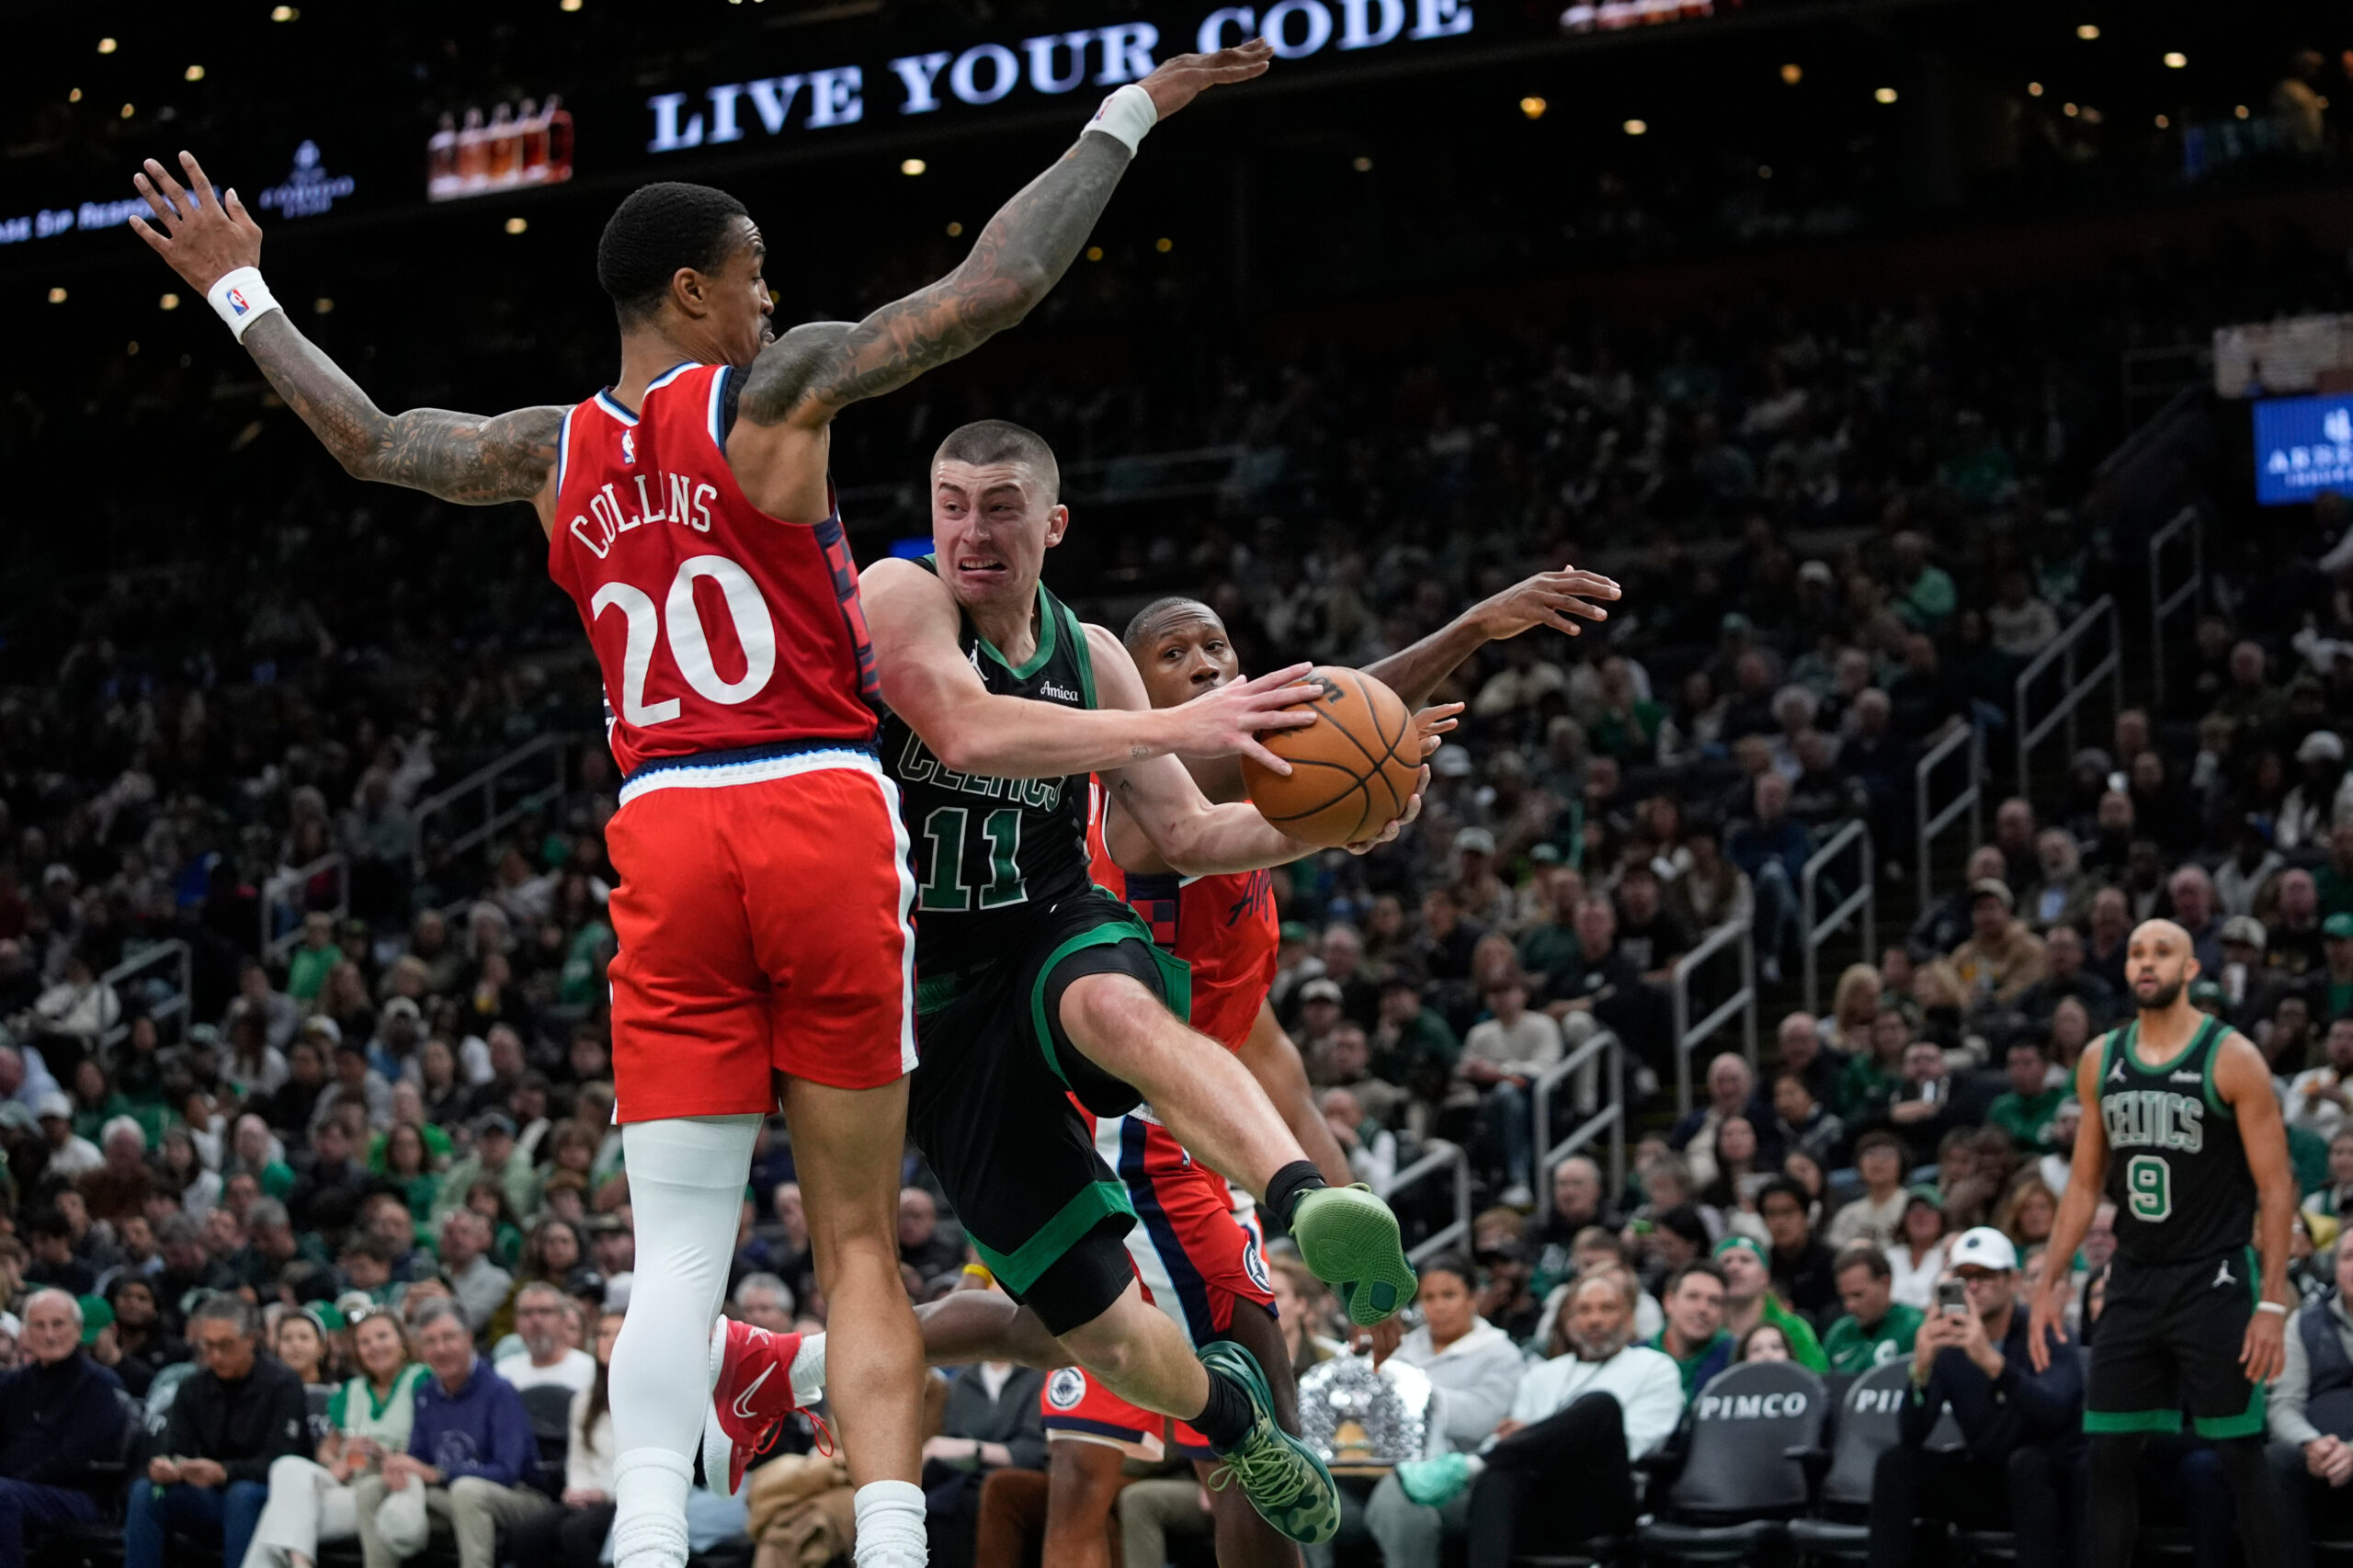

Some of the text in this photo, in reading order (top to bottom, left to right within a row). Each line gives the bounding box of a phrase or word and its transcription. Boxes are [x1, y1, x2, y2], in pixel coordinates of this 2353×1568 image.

[647, 0, 1473, 153] LIVE YOUR CODE
[570, 470, 718, 559] COLLNS
[591, 554, 776, 727] 20
[1040, 680, 1079, 701] Amica
[918, 806, 1029, 912] 11
[2101, 1090, 2204, 1154] CELTICS
[2127, 1154, 2172, 1223] 9
[1699, 1392, 1807, 1420] PIMCO
